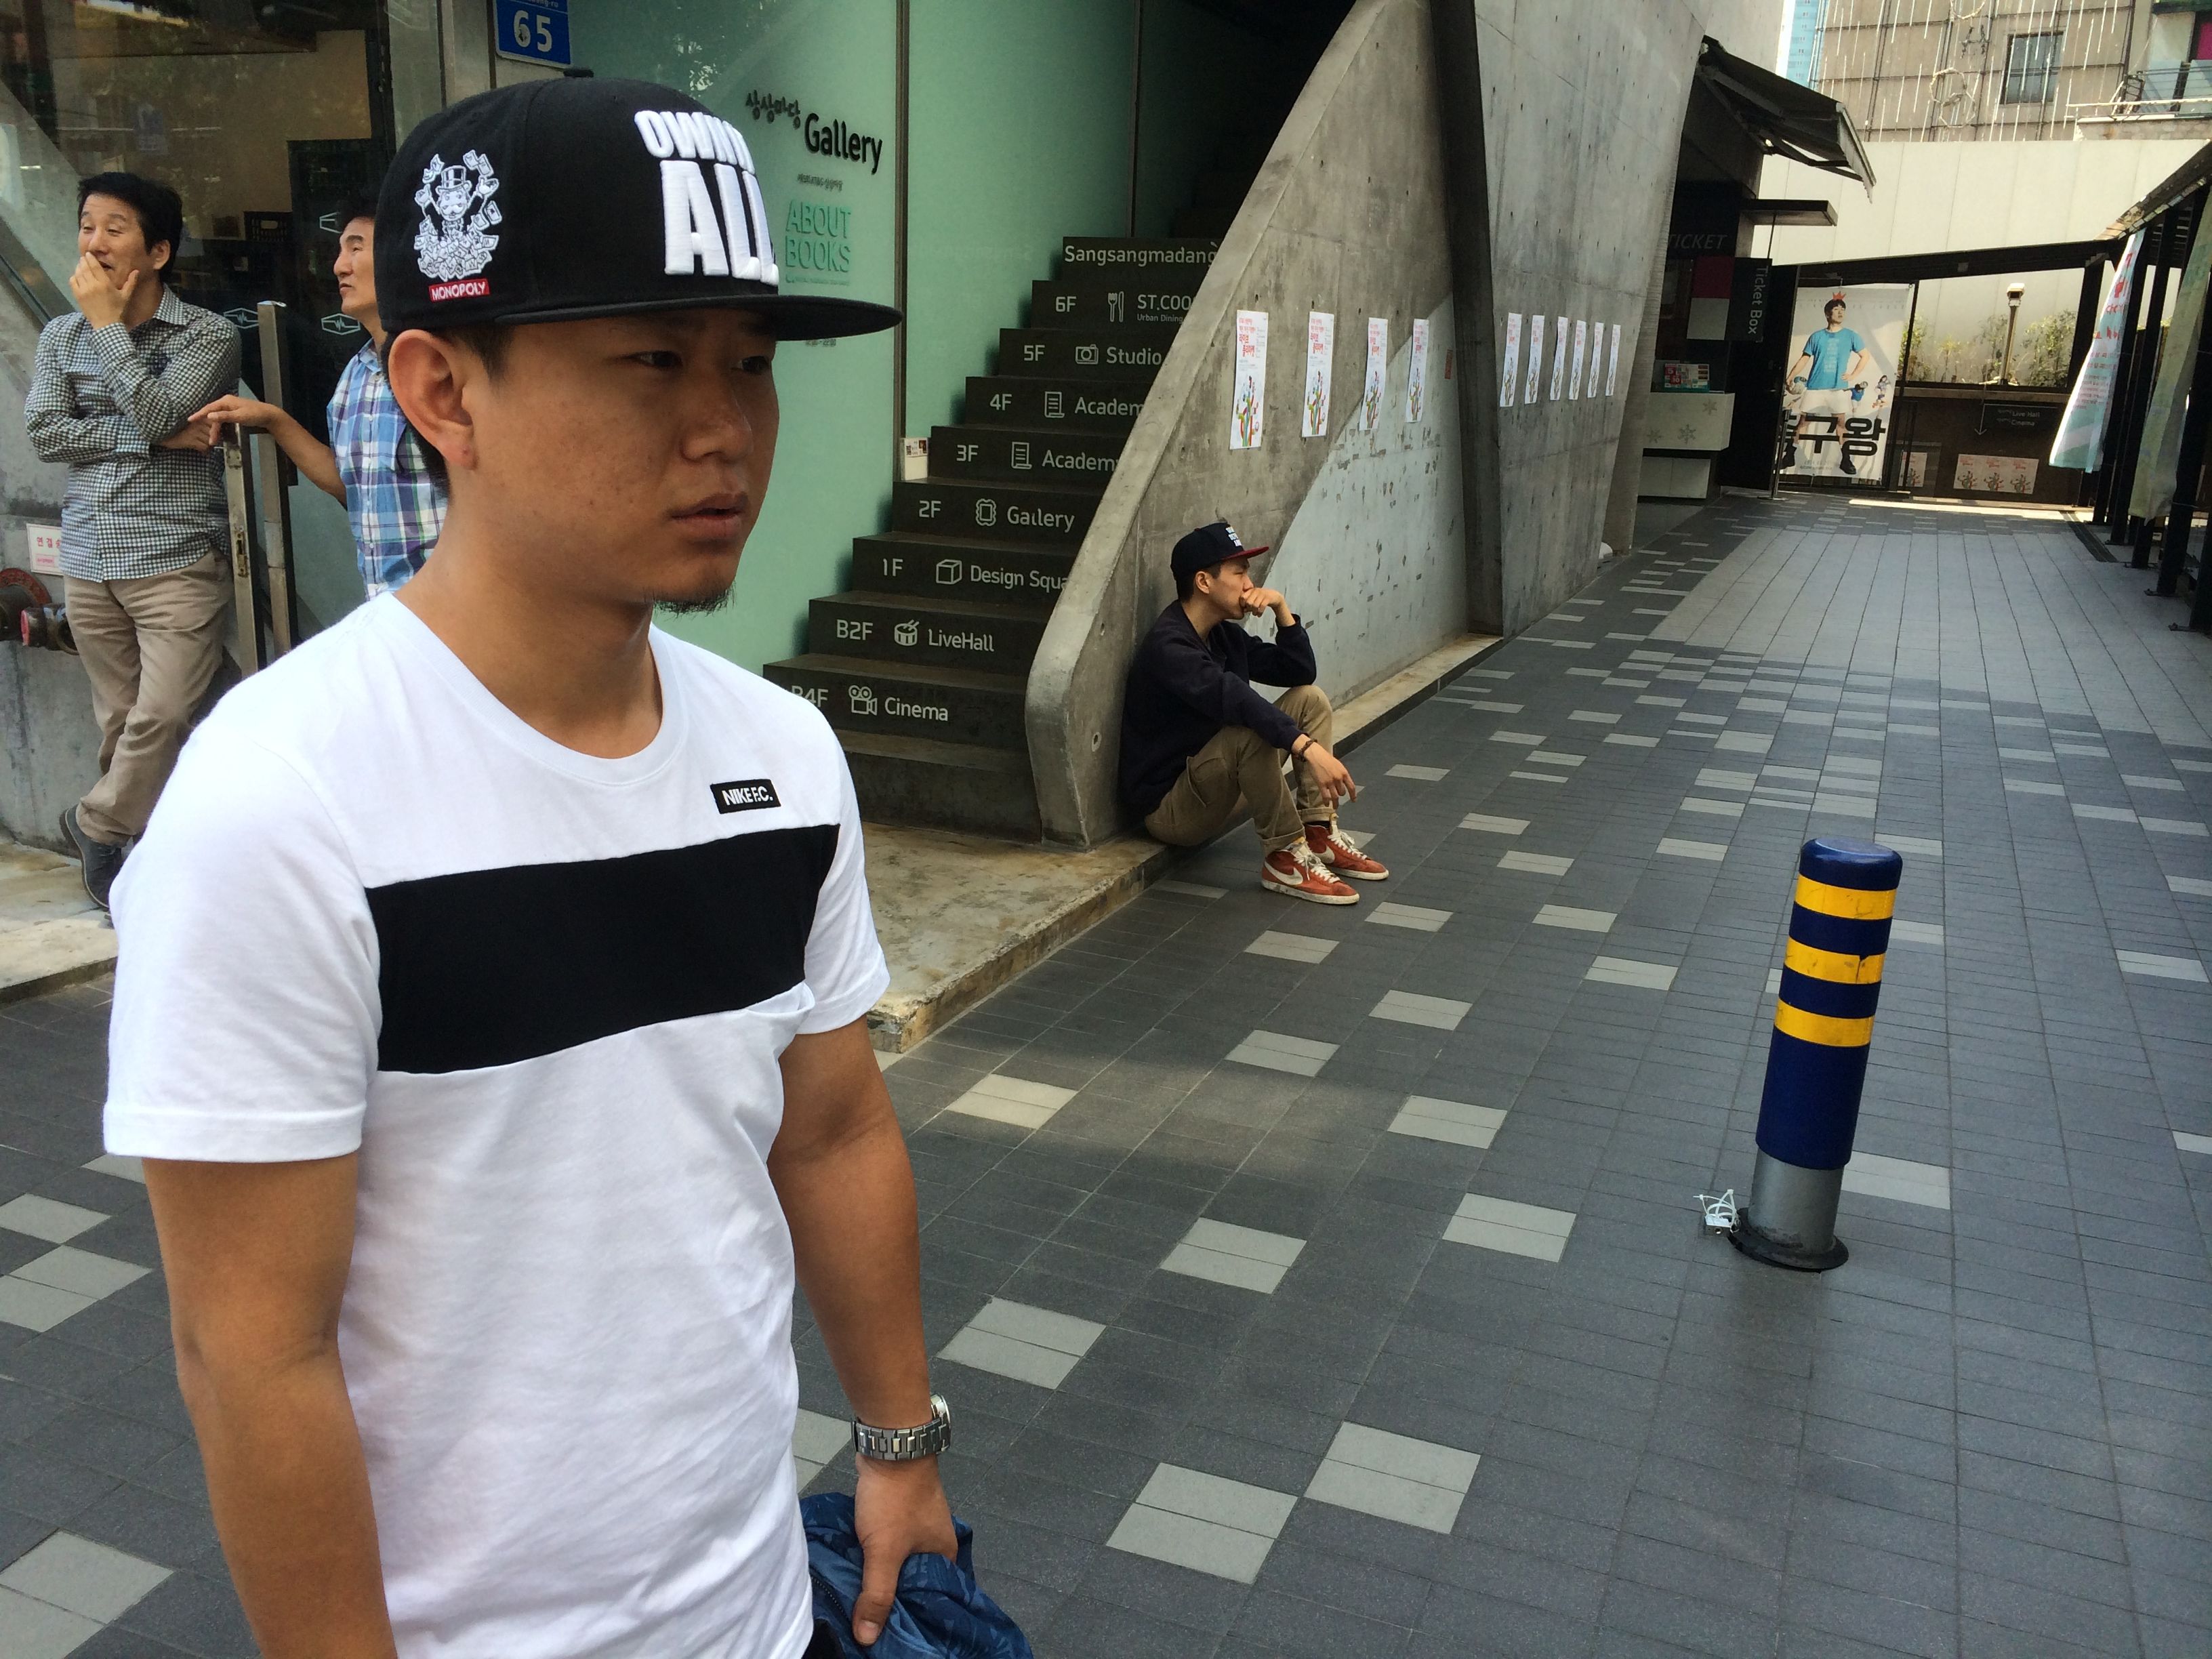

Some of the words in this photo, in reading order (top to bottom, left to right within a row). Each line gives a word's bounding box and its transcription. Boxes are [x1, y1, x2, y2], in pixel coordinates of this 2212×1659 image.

[513, 9, 553, 53] 65
[745, 89, 801, 130] 상상마당
[804, 112, 883, 176] Gallery
[659, 159, 779, 286] ALL
[785, 199, 852, 239] ABOUT
[785, 234, 851, 273] BOOKS
[431, 281, 486, 301] MONOPOLY
[1753, 265, 1769, 306] Ticket
[1055, 295, 1077, 313] 6F
[1136, 314, 1159, 322] Urban
[1748, 309, 1763, 335] Box
[1023, 344, 1046, 363] 5F
[1105, 346, 1162, 367] Studio
[989, 392, 1012, 411] 4F
[956, 444, 979, 462] 3F
[1042, 449, 1119, 472] Academ
[919, 500, 942, 518] 2F
[1006, 506, 1076, 533] Gallery
[882, 558, 904, 577] 1F
[970, 565, 1024, 590] Design
[836, 619, 874, 641] B2F
[884, 697, 949, 722] Cinema
